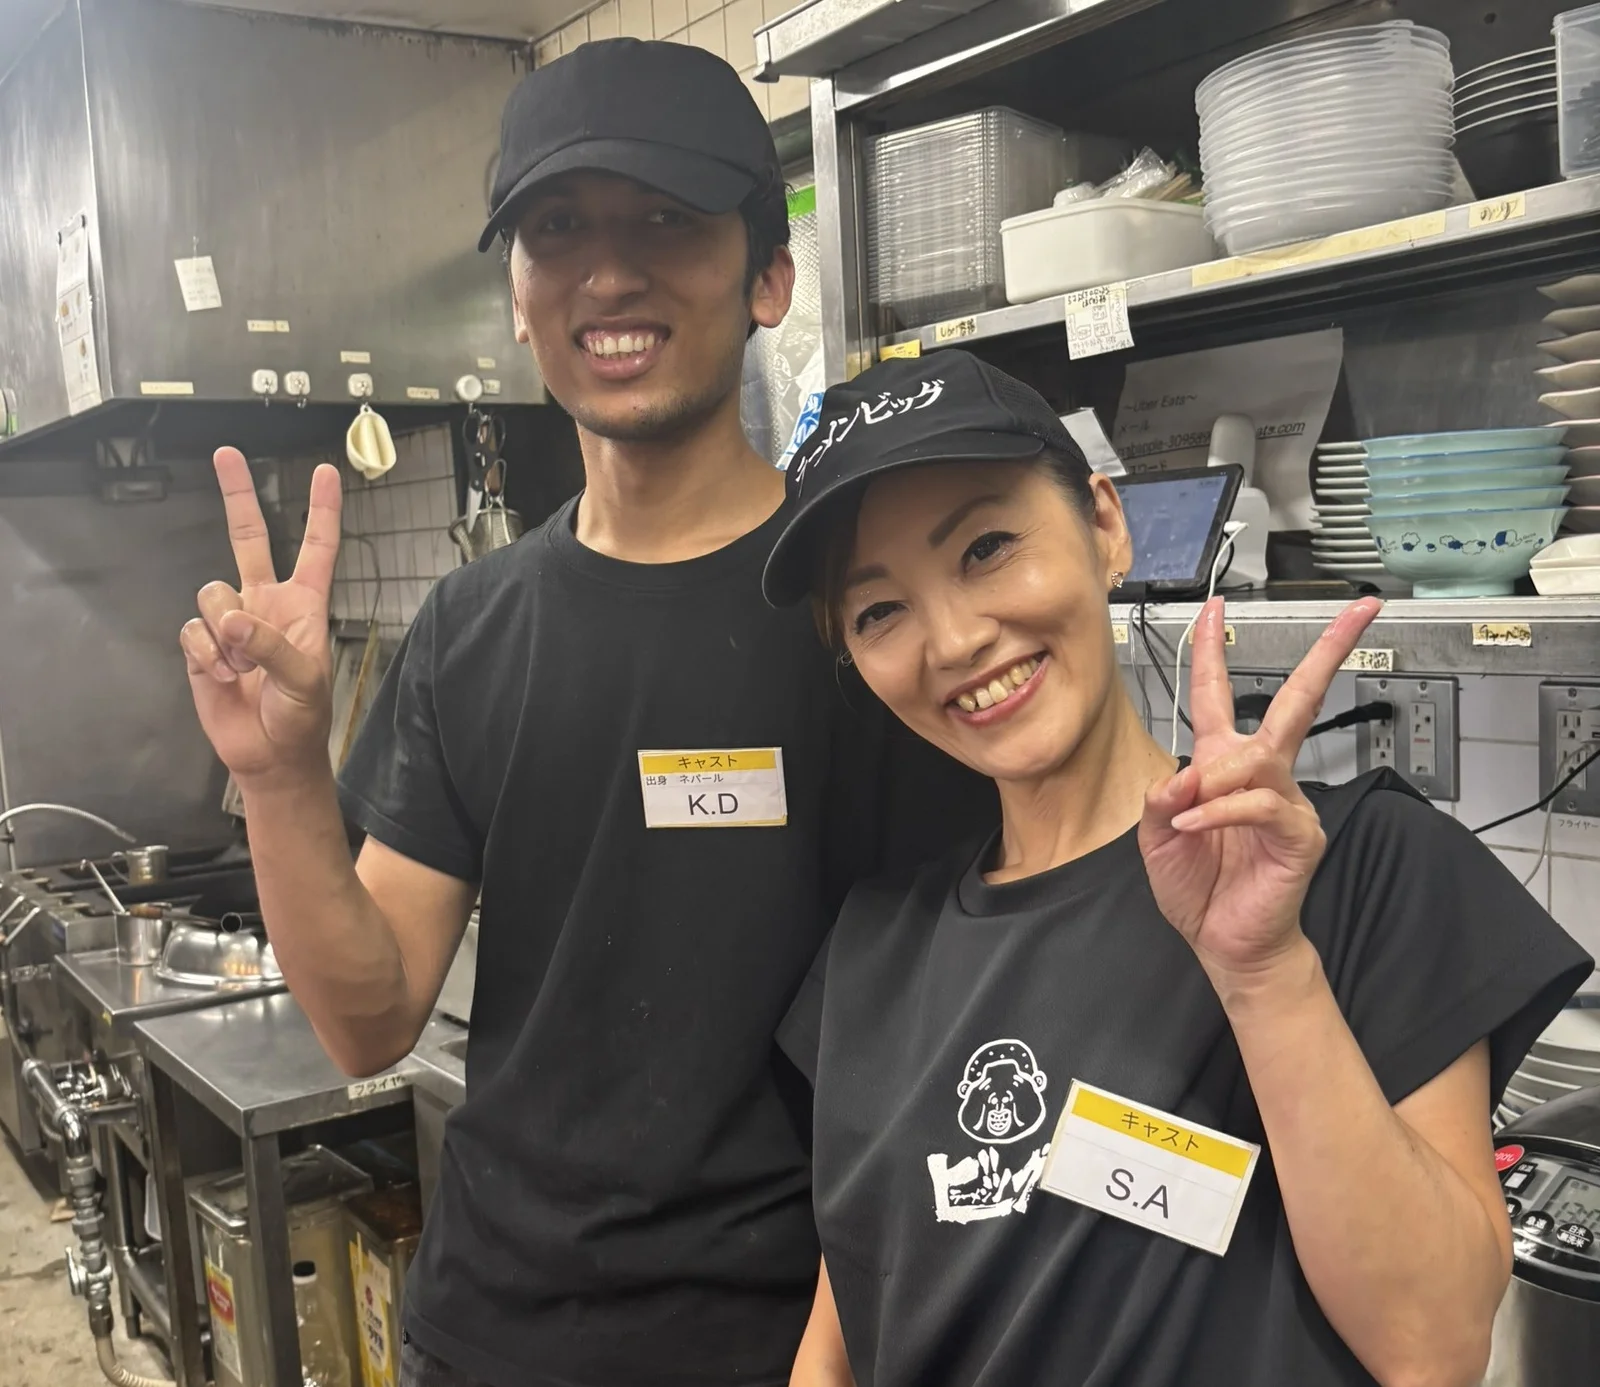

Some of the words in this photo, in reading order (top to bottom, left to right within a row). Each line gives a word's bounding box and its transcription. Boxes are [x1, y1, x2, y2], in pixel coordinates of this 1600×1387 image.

[678, 754, 738, 769] キャスト
[645, 775, 667, 786] 出身
[687, 793, 739, 816] K.D
[1121, 1111, 1199, 1152] キャスト
[1105, 1168, 1169, 1219] S.A
